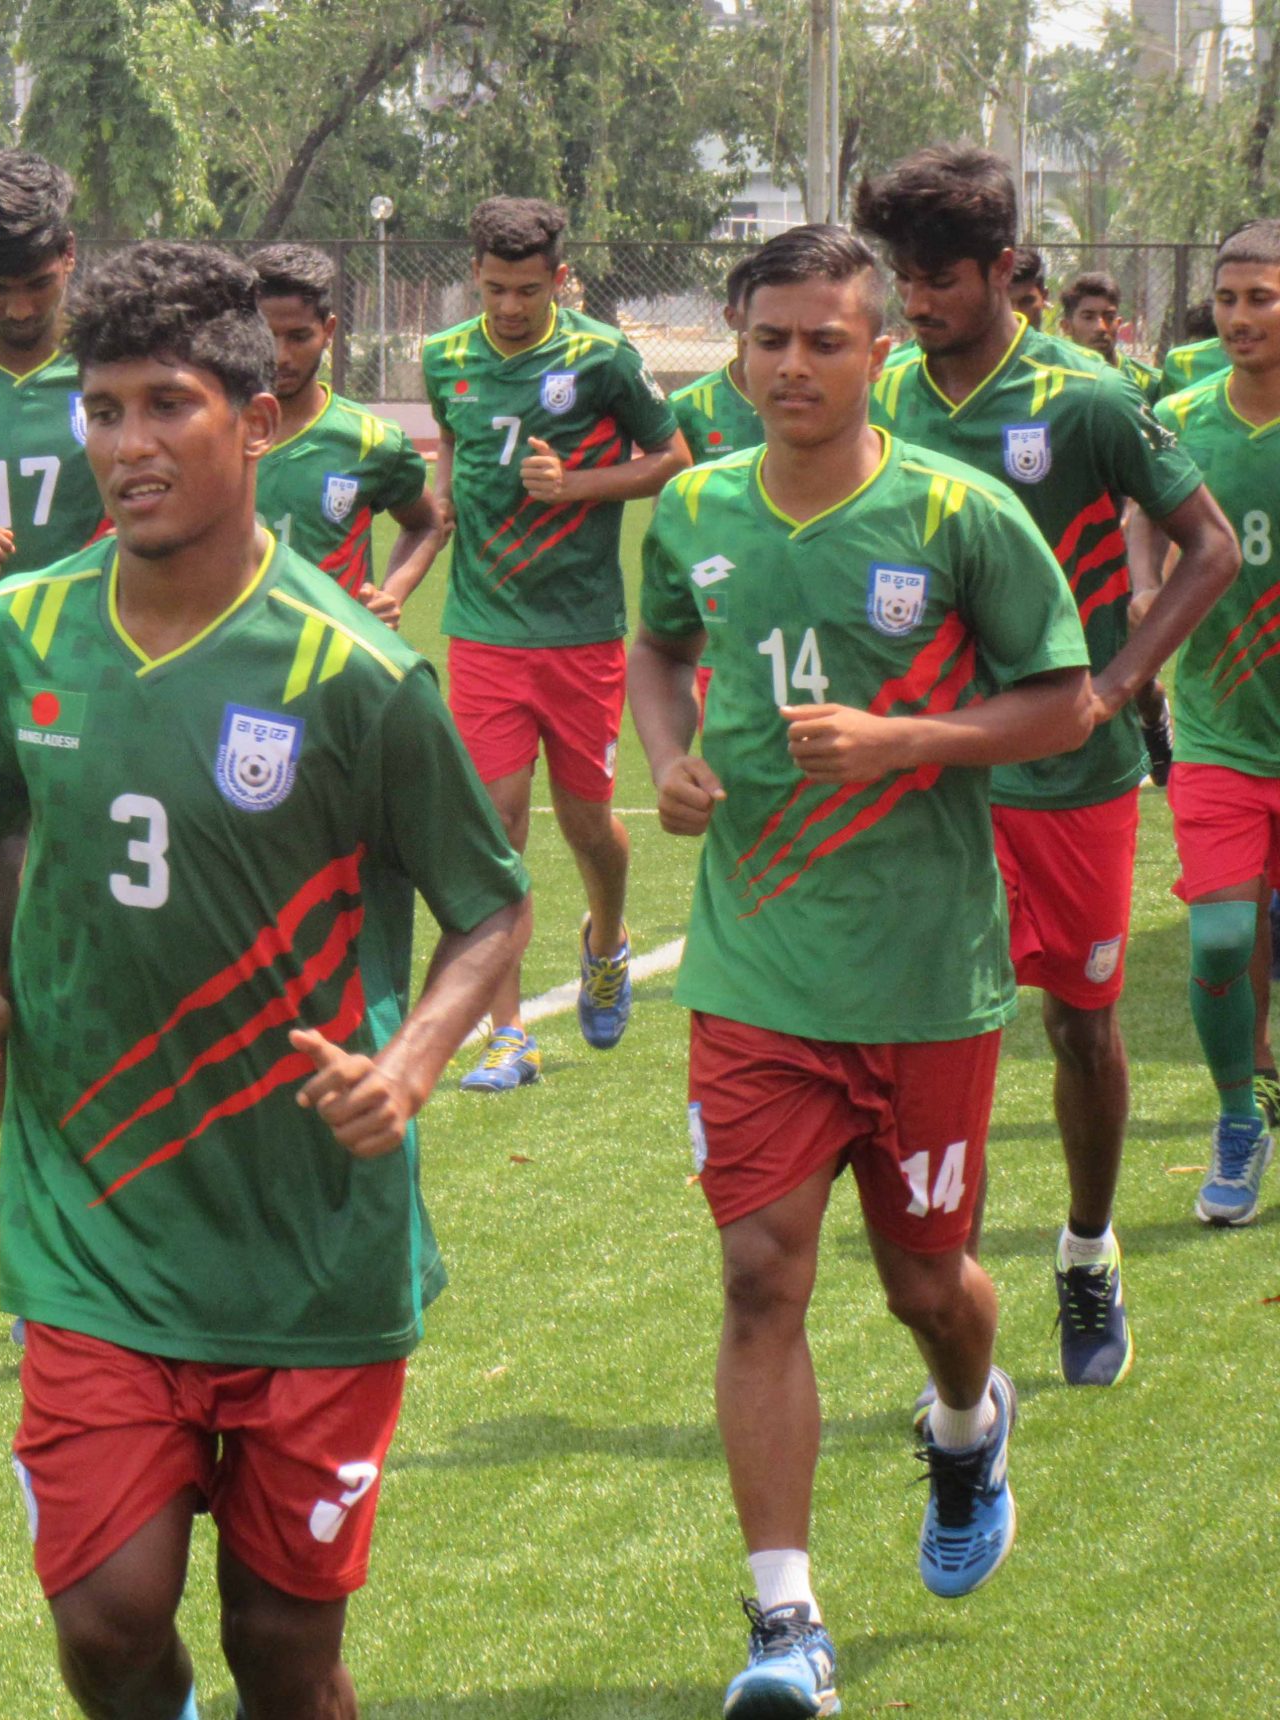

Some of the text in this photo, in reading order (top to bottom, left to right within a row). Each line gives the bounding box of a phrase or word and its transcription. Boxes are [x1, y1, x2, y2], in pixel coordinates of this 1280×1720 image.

[492, 416, 521, 466] 7
[1242, 509, 1272, 566] 8
[757, 627, 829, 707] 14
[109, 793, 169, 909] 3
[899, 1139, 968, 1218] 14
